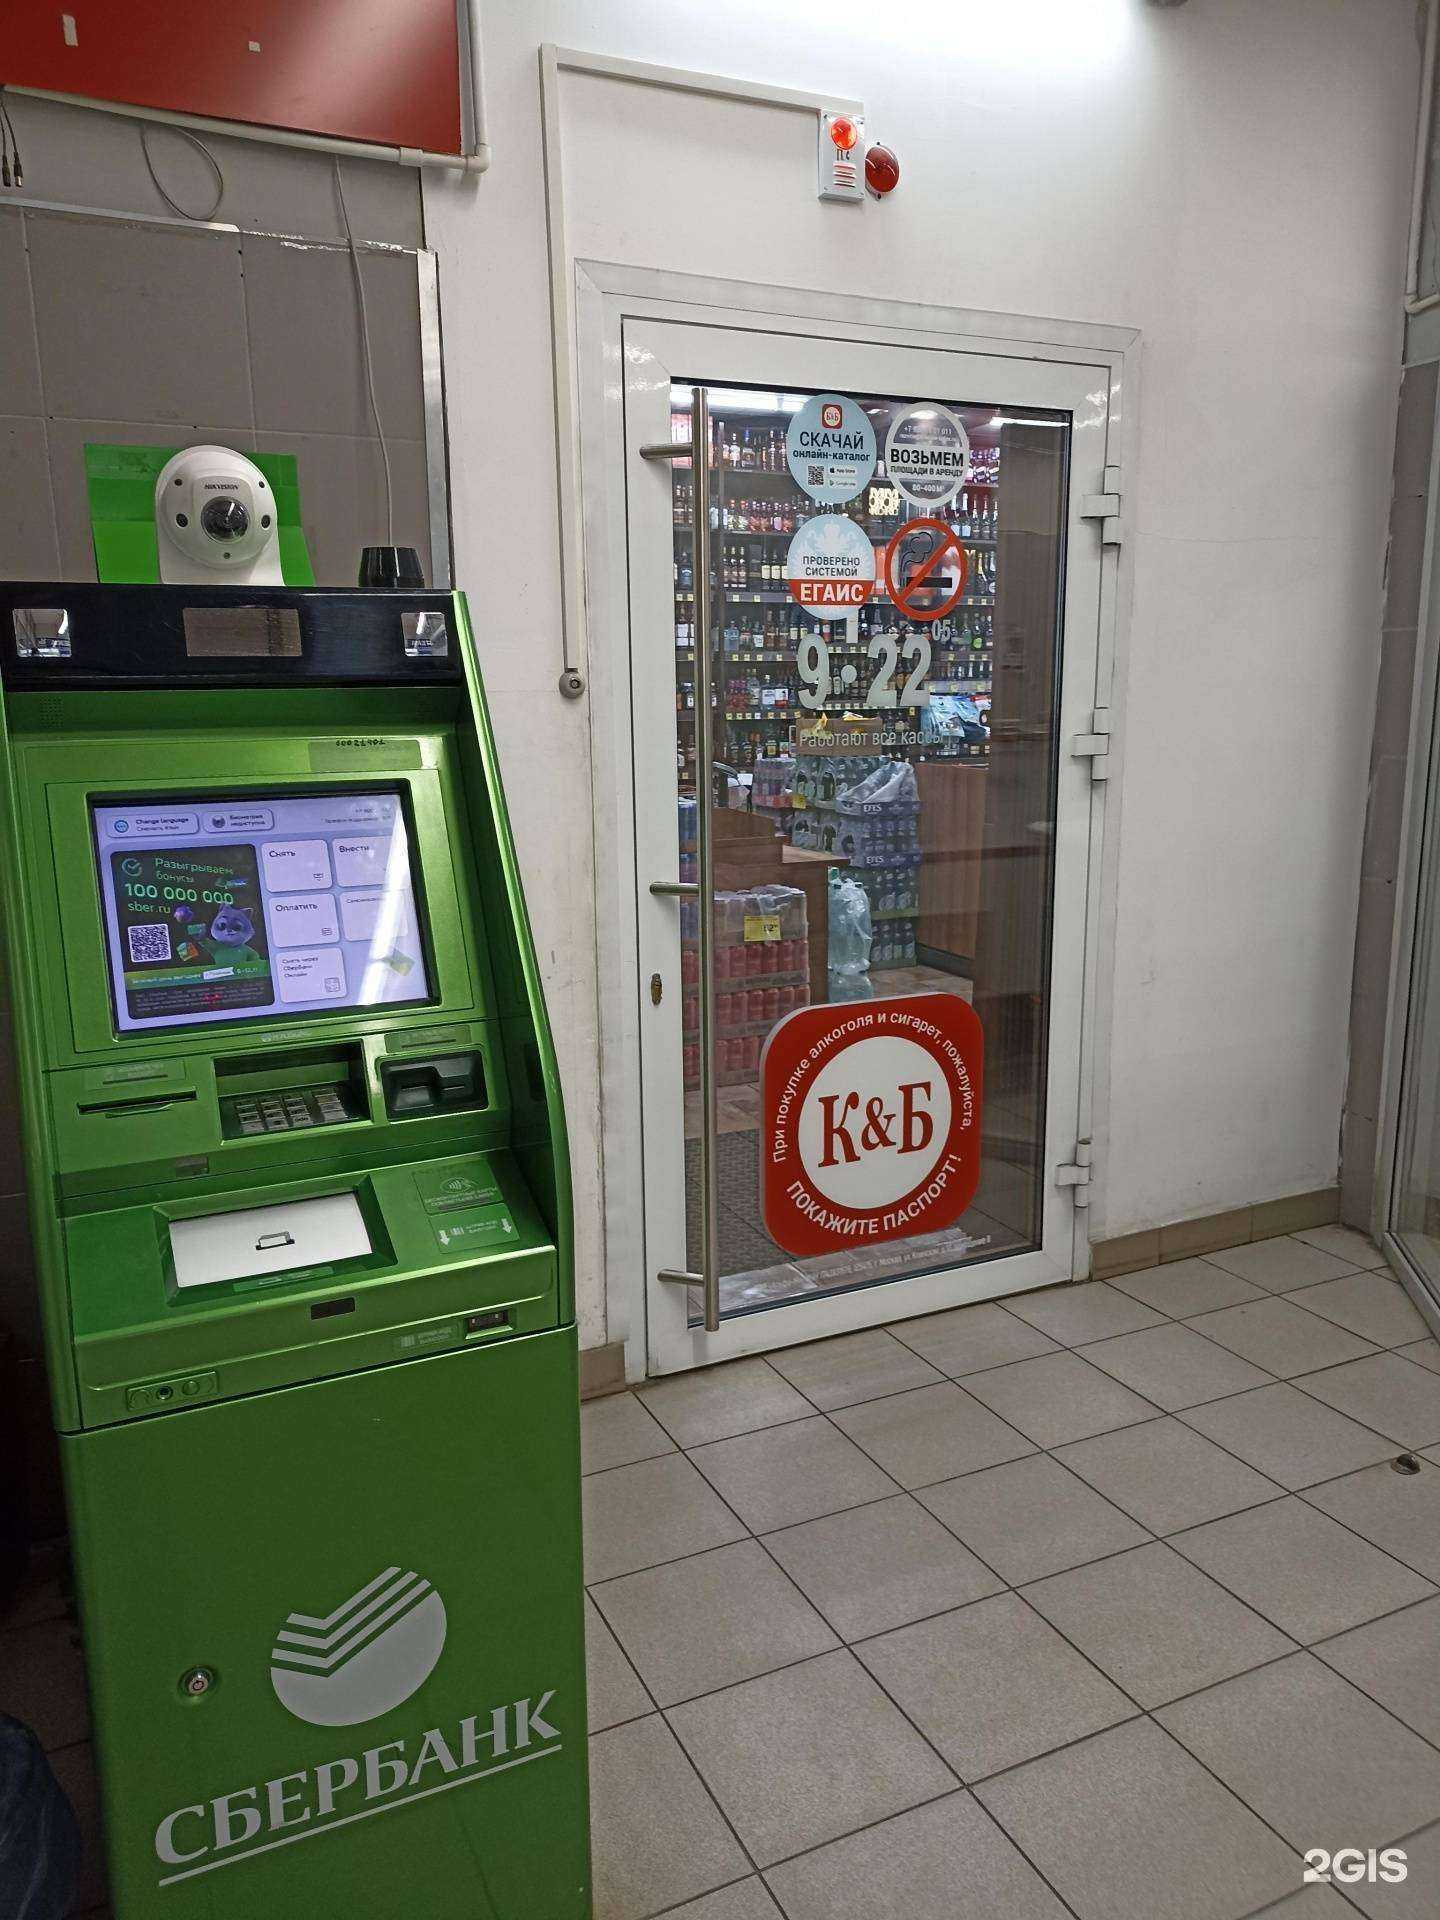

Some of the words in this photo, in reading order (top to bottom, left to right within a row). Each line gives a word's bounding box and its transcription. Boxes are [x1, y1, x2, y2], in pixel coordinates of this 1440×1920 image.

[800, 431, 864, 450] СКАЧАЙ
[792, 449, 871, 462] онлайн-каталог
[890, 449, 964, 467] ВОЗЬМЕМ
[891, 466, 928, 476] ПЛОЩАДИ
[935, 469, 963, 477] АРЕНДУ
[802, 556, 861, 566] ПРОВЕРЕНО
[805, 566, 858, 577] СИСТЕМОЙ
[800, 583, 864, 602] ЕГАИС
[800, 730, 868, 748] Работают
[872, 731, 897, 746] все
[135, 818, 160, 826] Change
[269, 850, 296, 858] Снять
[339, 845, 370, 853] Внести
[154, 858, 234, 875] Разыгрываем
[156, 870, 195, 884] бонусы
[124, 882, 158, 898] 100
[163, 886, 198, 902] 000
[202, 890, 234, 905] 000
[128, 901, 171, 913] sber.ru
[275, 904, 318, 912] Оплатить
[877, 1013, 887, 1023] и
[809, 1013, 874, 1060] алкоголя
[890, 1012, 943, 1045] сигарет,
[776, 1058, 811, 1126] покупке
[941, 1039, 974, 1131] пожалуйста,
[817, 1081, 935, 1168] К&Б
[772, 1130, 787, 1164] При
[786, 1180, 879, 1235] ПОКАЖИТЕ
[154, 1689, 562, 1864] СБЕРБАНК
